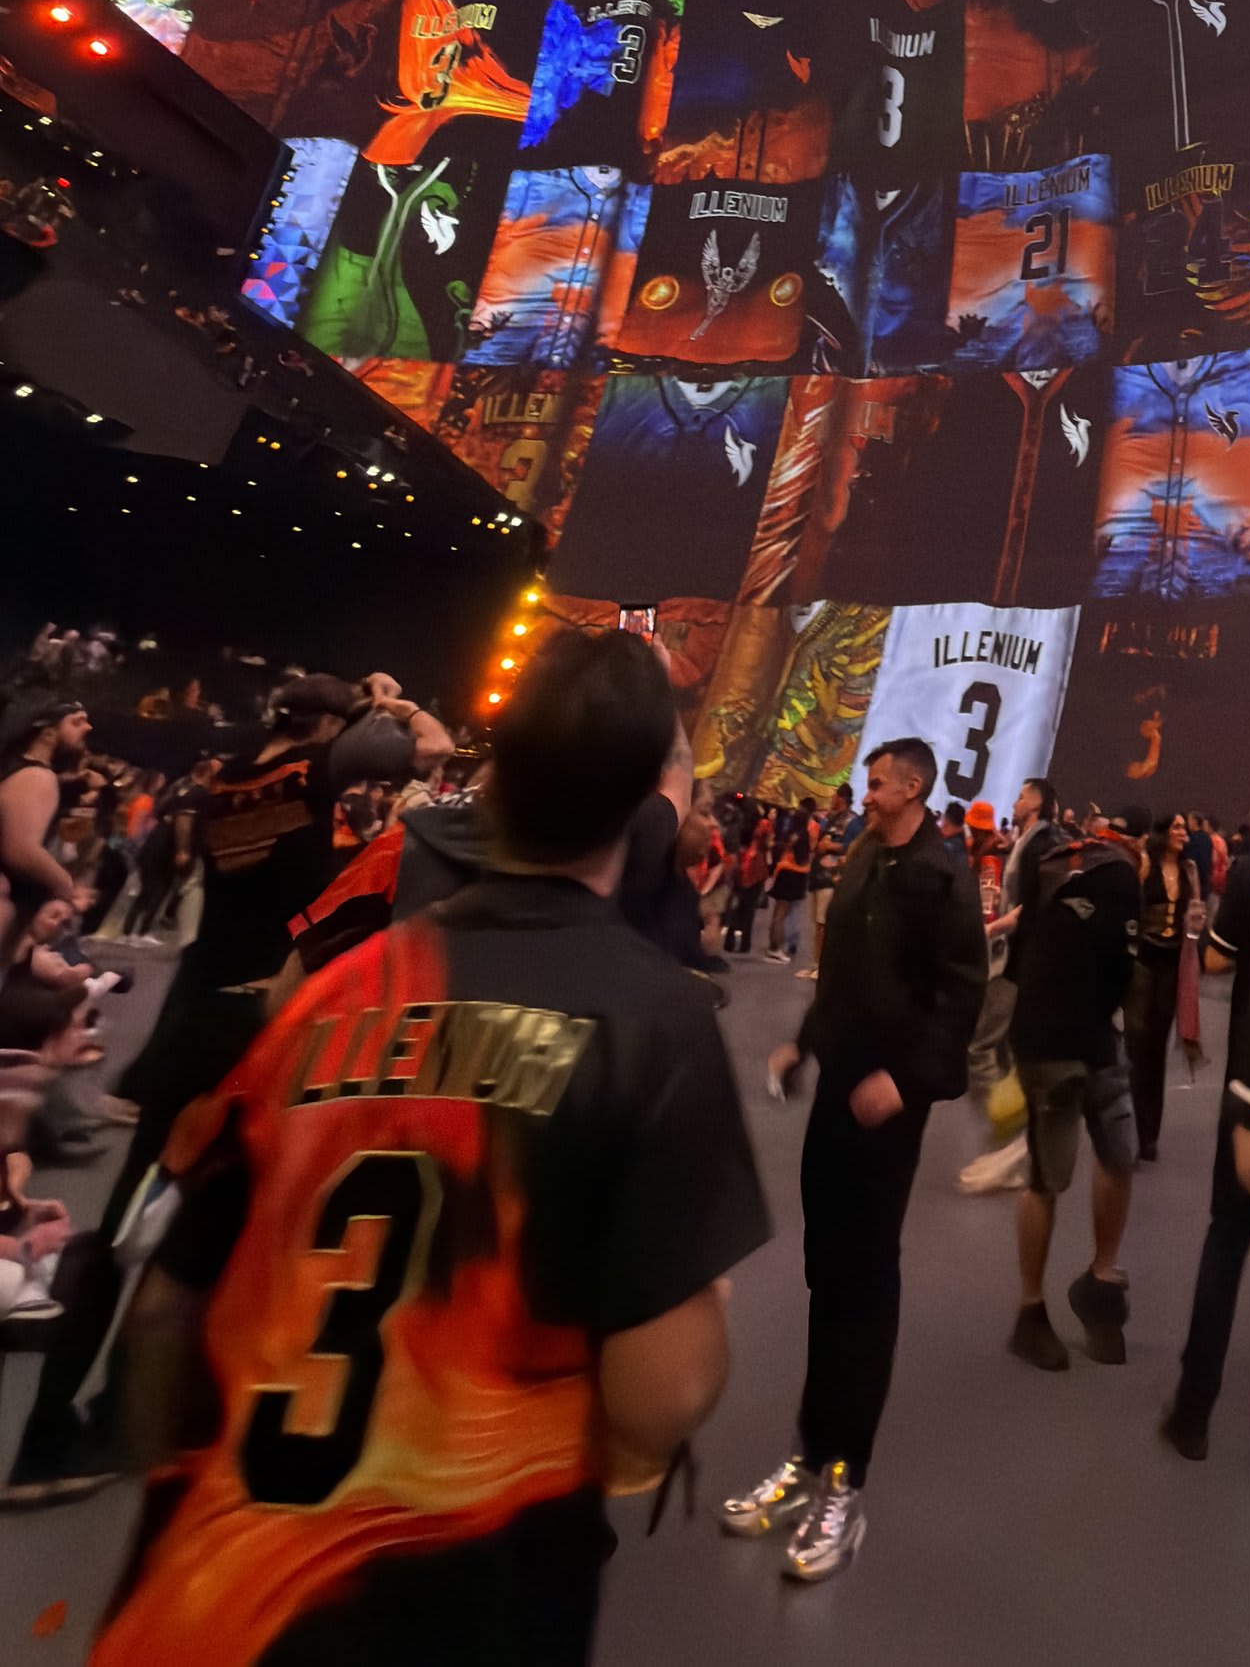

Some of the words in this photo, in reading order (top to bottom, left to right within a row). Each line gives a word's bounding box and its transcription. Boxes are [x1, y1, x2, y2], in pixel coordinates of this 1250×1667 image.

[611, 25, 645, 84] 3
[878, 66, 904, 147] 3
[689, 189, 788, 225] ILLENIUM
[1004, 166, 1090, 208] ILLENIUM
[1020, 213, 1069, 283] 21
[935, 631, 1044, 675] ILLENIUM
[945, 681, 1001, 801] 3
[242, 1150, 442, 1510] 3
